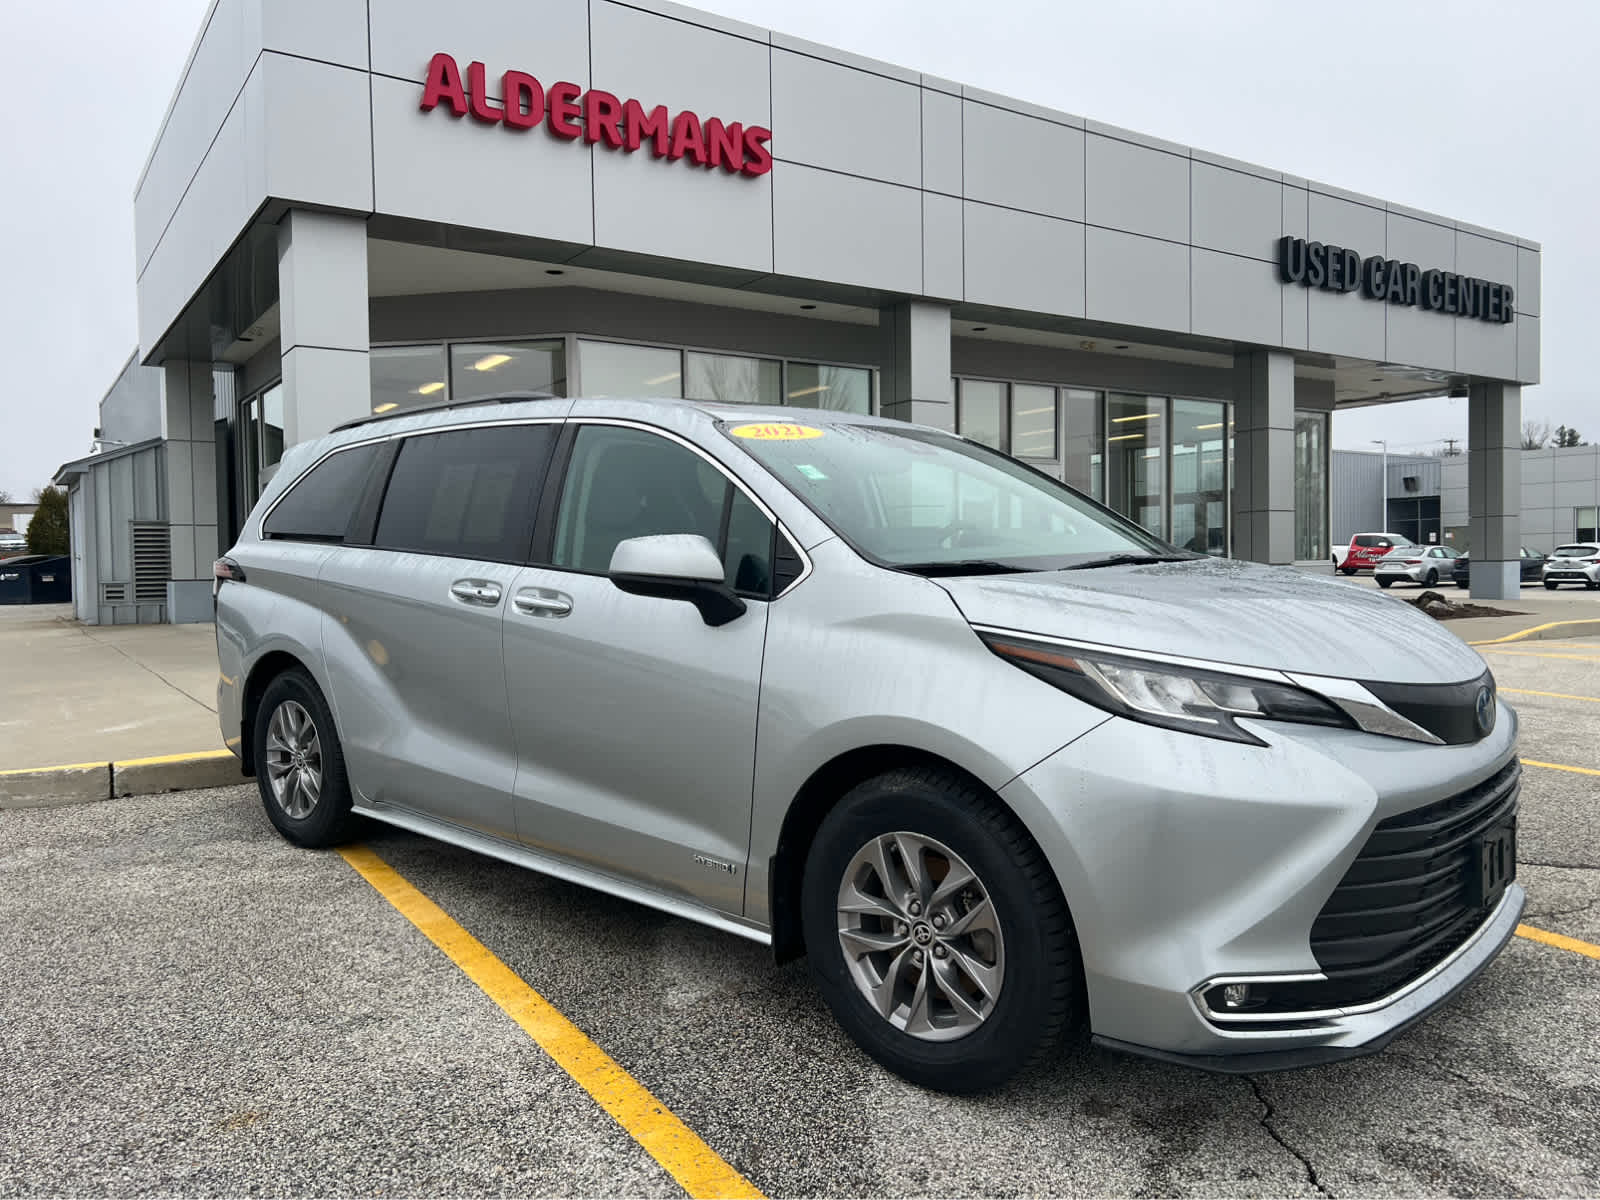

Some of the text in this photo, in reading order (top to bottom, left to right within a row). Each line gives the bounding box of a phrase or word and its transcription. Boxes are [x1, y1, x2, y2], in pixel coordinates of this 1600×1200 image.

[420, 53, 772, 177] ALDERMANS
[1280, 236, 1514, 323] USED CAR CENTER
[753, 426, 804, 437] 2021
